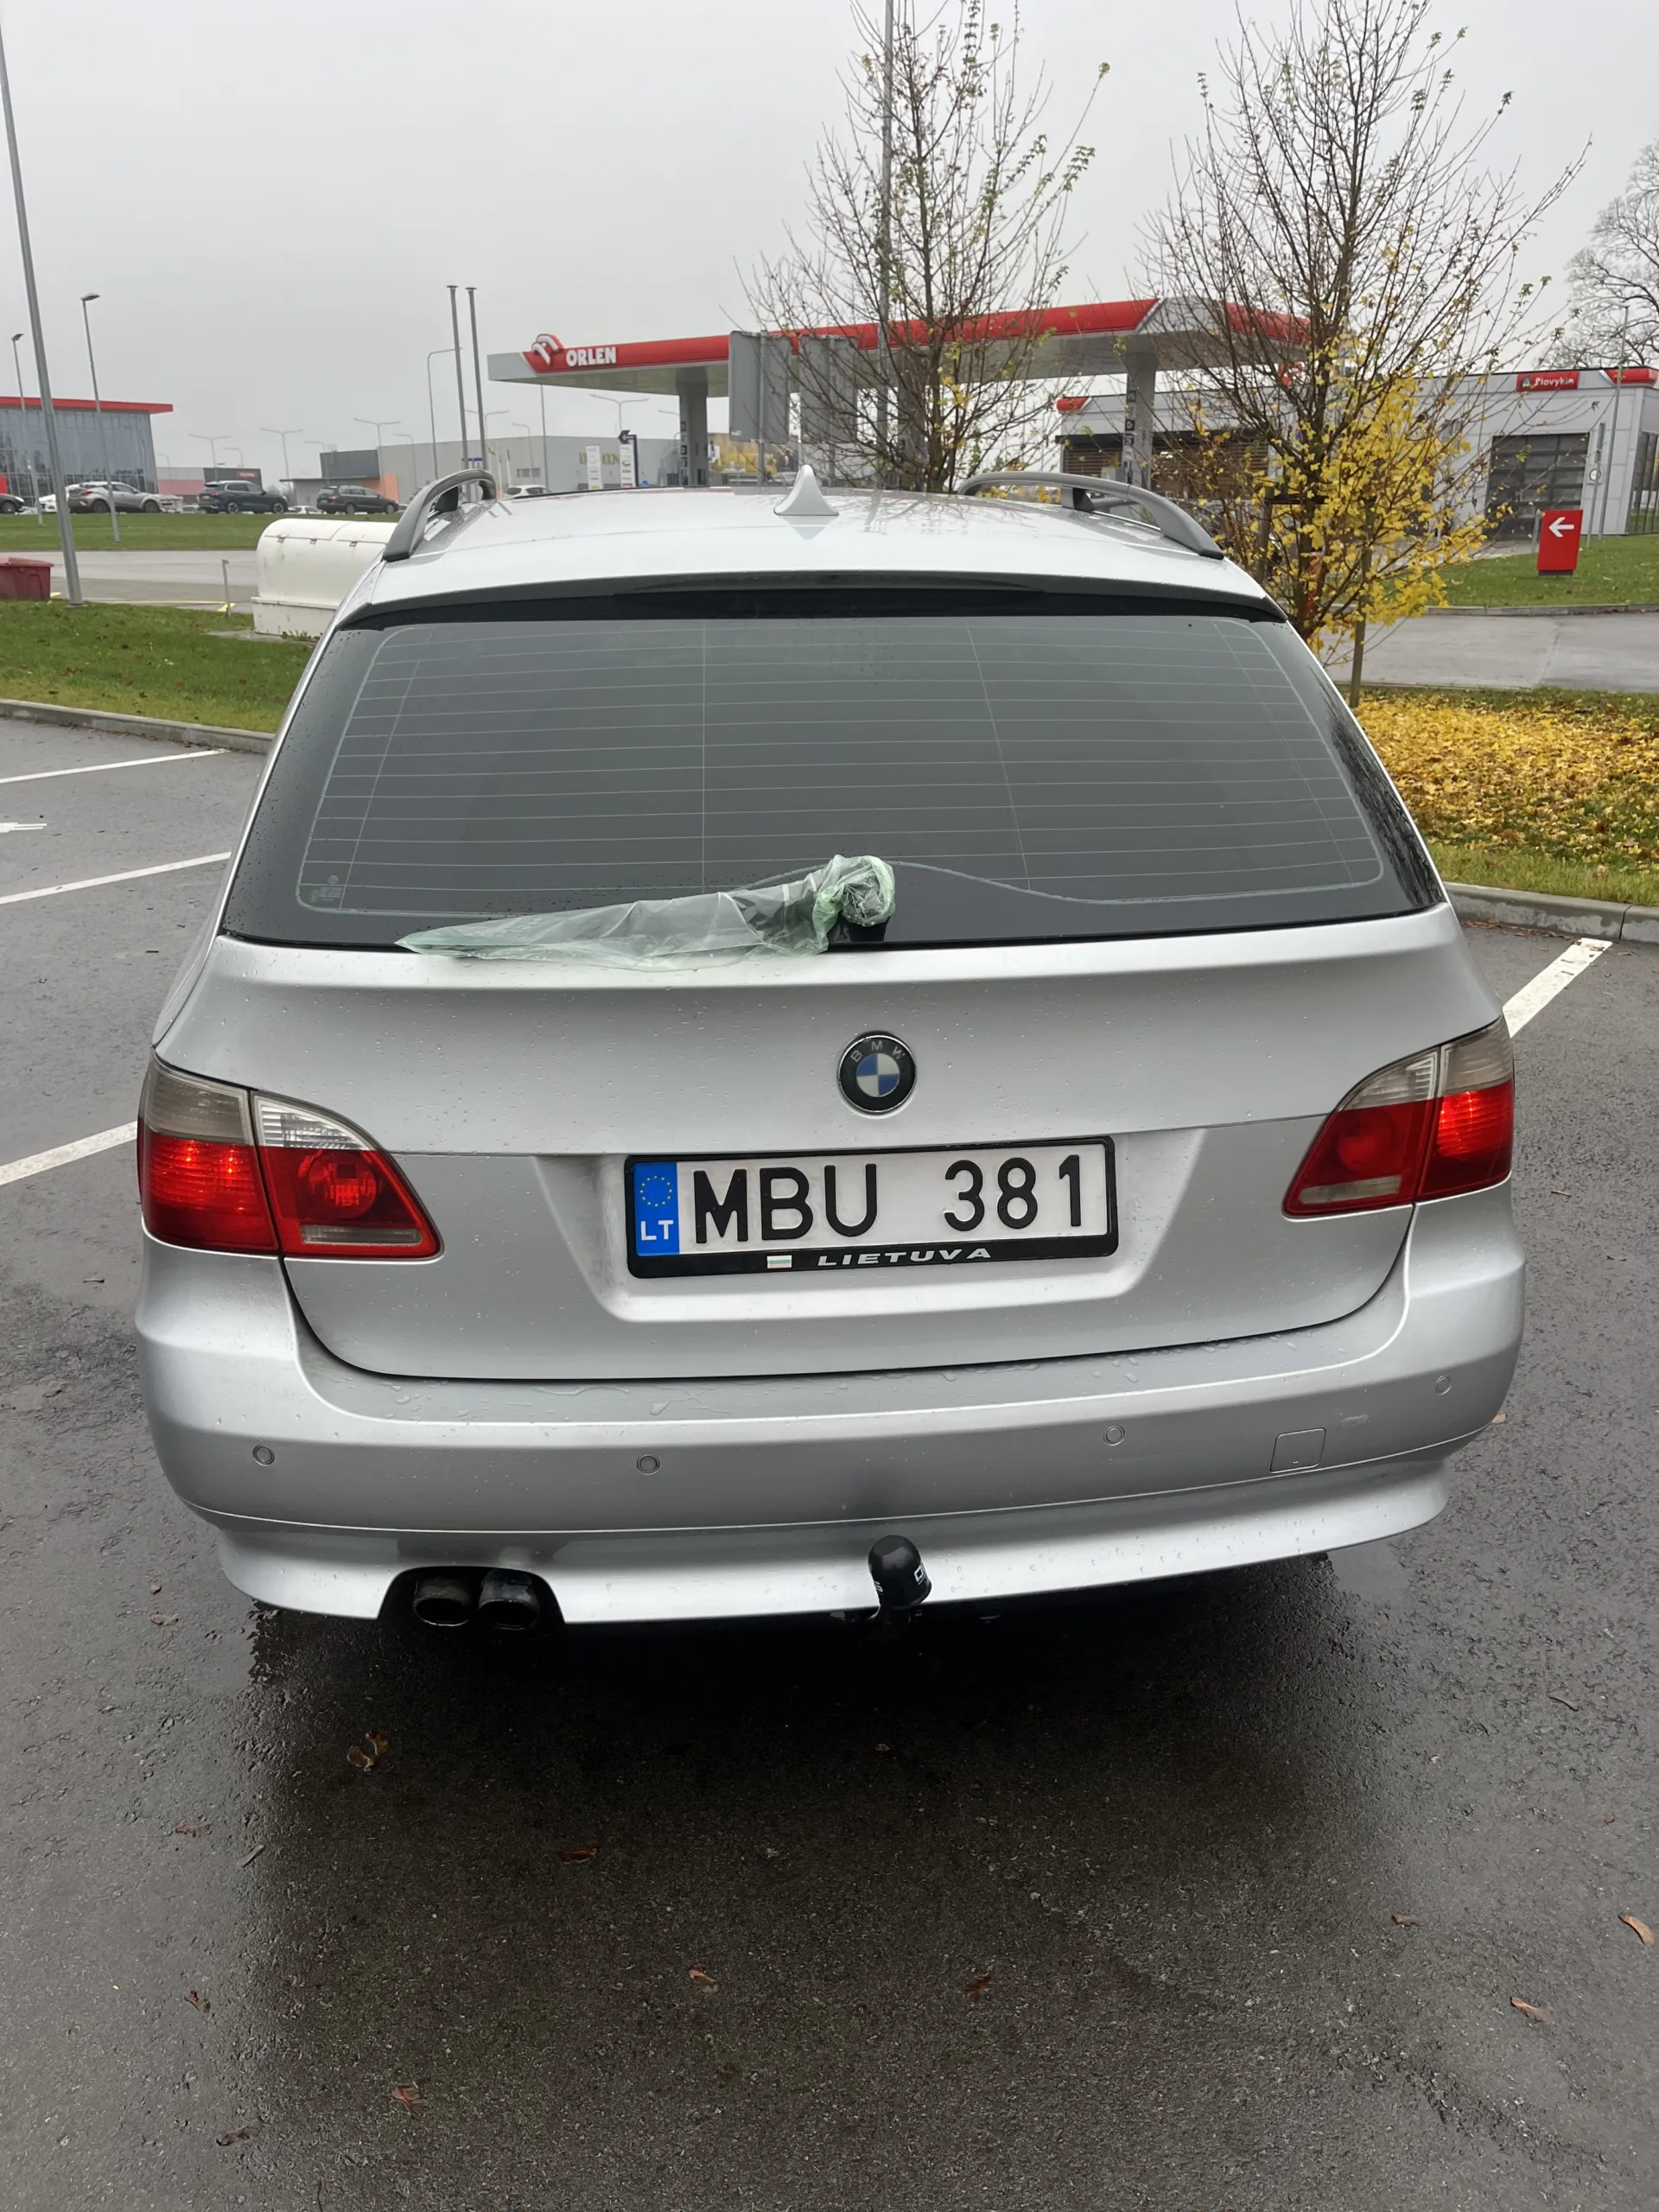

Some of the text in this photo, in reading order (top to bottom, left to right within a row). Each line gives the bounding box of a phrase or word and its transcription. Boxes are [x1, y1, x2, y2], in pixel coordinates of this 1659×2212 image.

[566, 346, 617, 366] ORLEN
[850, 1039, 906, 1063] BMW
[694, 1154, 1082, 1243] MBU 381
[640, 1221, 674, 1241] LT
[817, 1247, 993, 1267] LIETUVA
